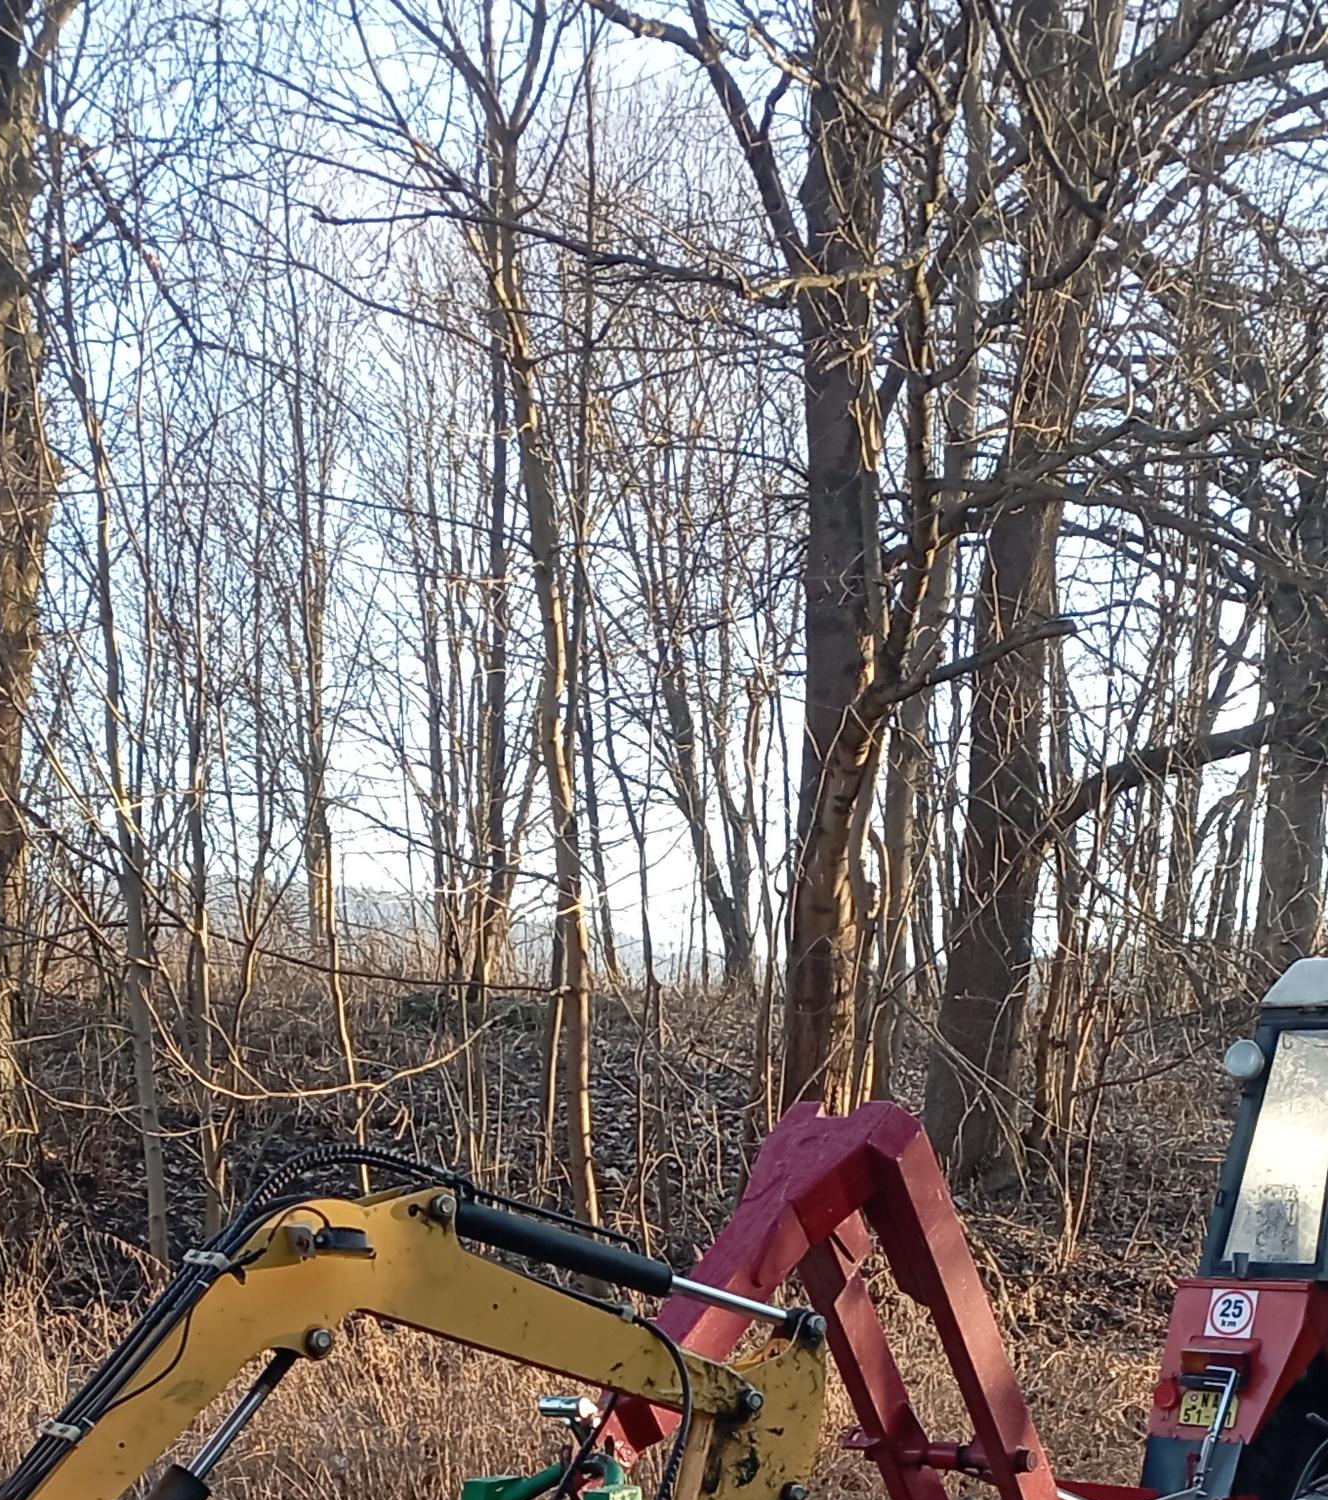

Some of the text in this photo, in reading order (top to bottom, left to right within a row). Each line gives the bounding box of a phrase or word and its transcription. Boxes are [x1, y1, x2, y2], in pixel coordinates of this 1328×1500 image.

[1219, 1298, 1244, 1319] 25
[1221, 1319, 1237, 1328] km
[1183, 1407, 1232, 1426] 51-1
